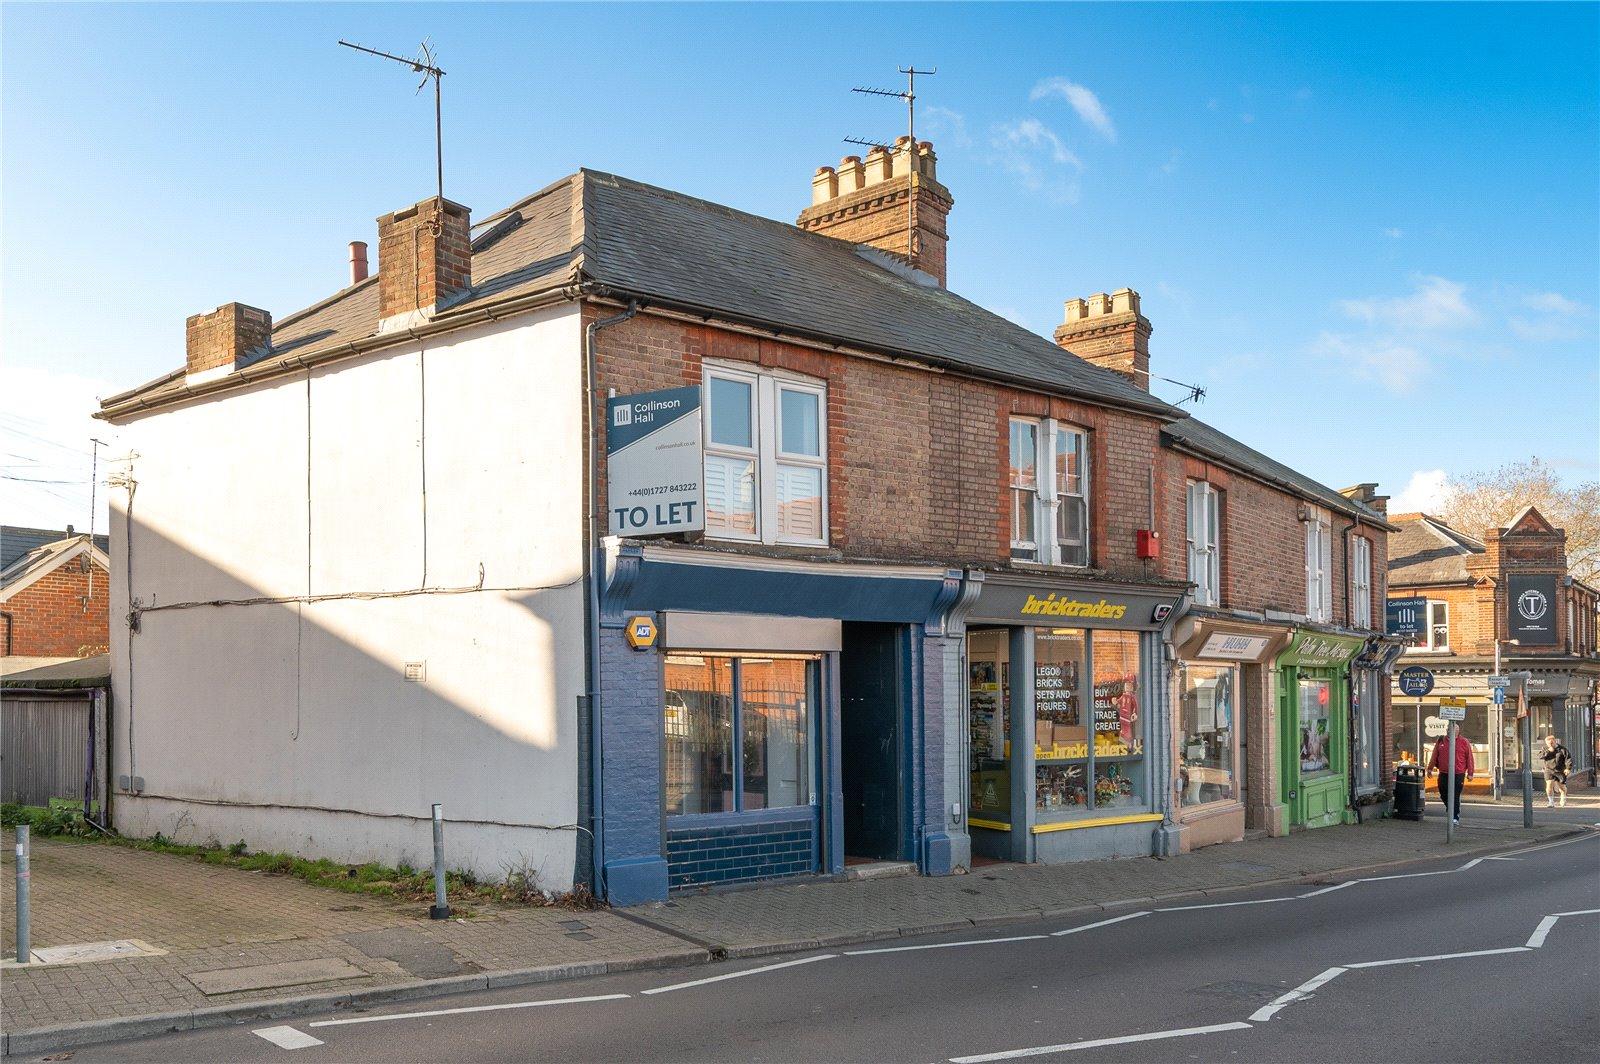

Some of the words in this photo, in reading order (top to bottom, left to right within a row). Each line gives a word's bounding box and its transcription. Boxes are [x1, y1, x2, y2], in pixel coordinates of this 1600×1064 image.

[634, 399, 680, 413] Collinson
[634, 412, 654, 423] Hall
[656, 441, 696, 450] collinsonhall.co.uk
[628, 486, 668, 497] +44(0)1727
[669, 483, 697, 493] 843222
[615, 506, 648, 530] TO
[656, 500, 697, 526] LET
[1021, 593, 1127, 619] bricktraders
[636, 626, 650, 636] ADT
[1036, 678, 1063, 688] BRICKS
[1036, 690, 1056, 699] SETS
[1056, 690, 1071, 699] AND
[1094, 689, 1109, 697] BUY
[1036, 702, 1067, 711] FIGURES
[1094, 700, 1111, 709] SELL
[1095, 711, 1117, 720] TRADE
[1095, 721, 1121, 731] CREATE
